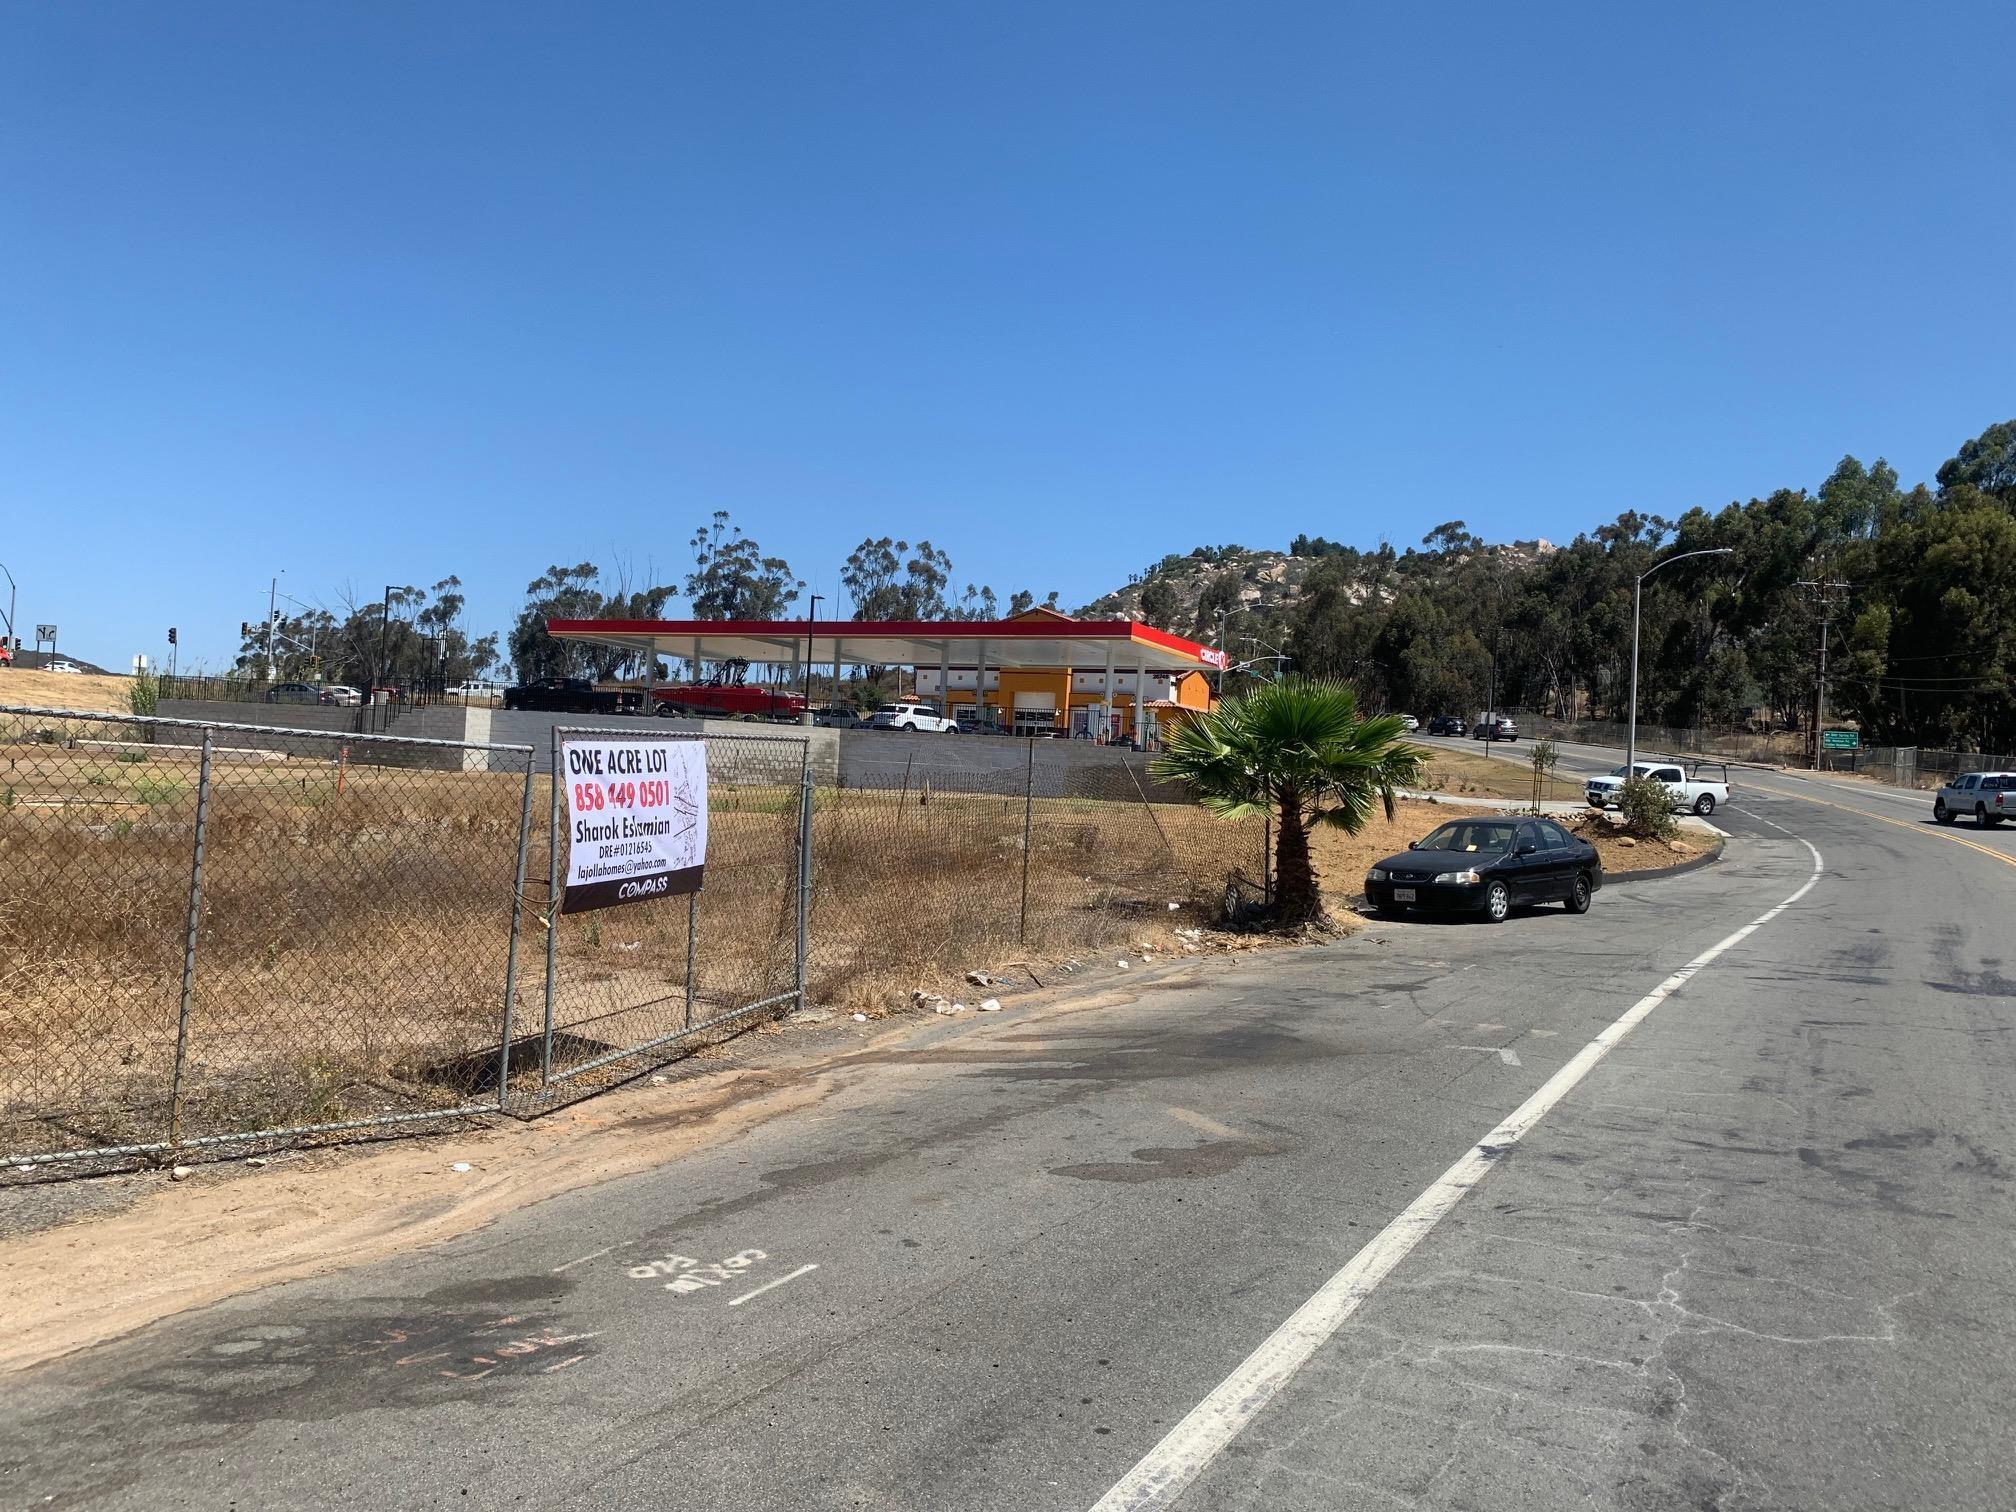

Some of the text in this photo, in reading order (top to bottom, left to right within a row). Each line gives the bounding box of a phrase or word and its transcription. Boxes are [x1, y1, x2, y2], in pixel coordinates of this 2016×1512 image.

[1200, 648, 1219, 665] CIRCLE
[569, 749, 668, 775] ONE ACRE LOT
[575, 783, 605, 811] 858
[639, 780, 670, 808] 0501
[575, 815, 670, 844] Sharok Eslamian
[578, 857, 667, 881] lajollahomes@yahoo.com
[618, 876, 668, 899] COMPASS
